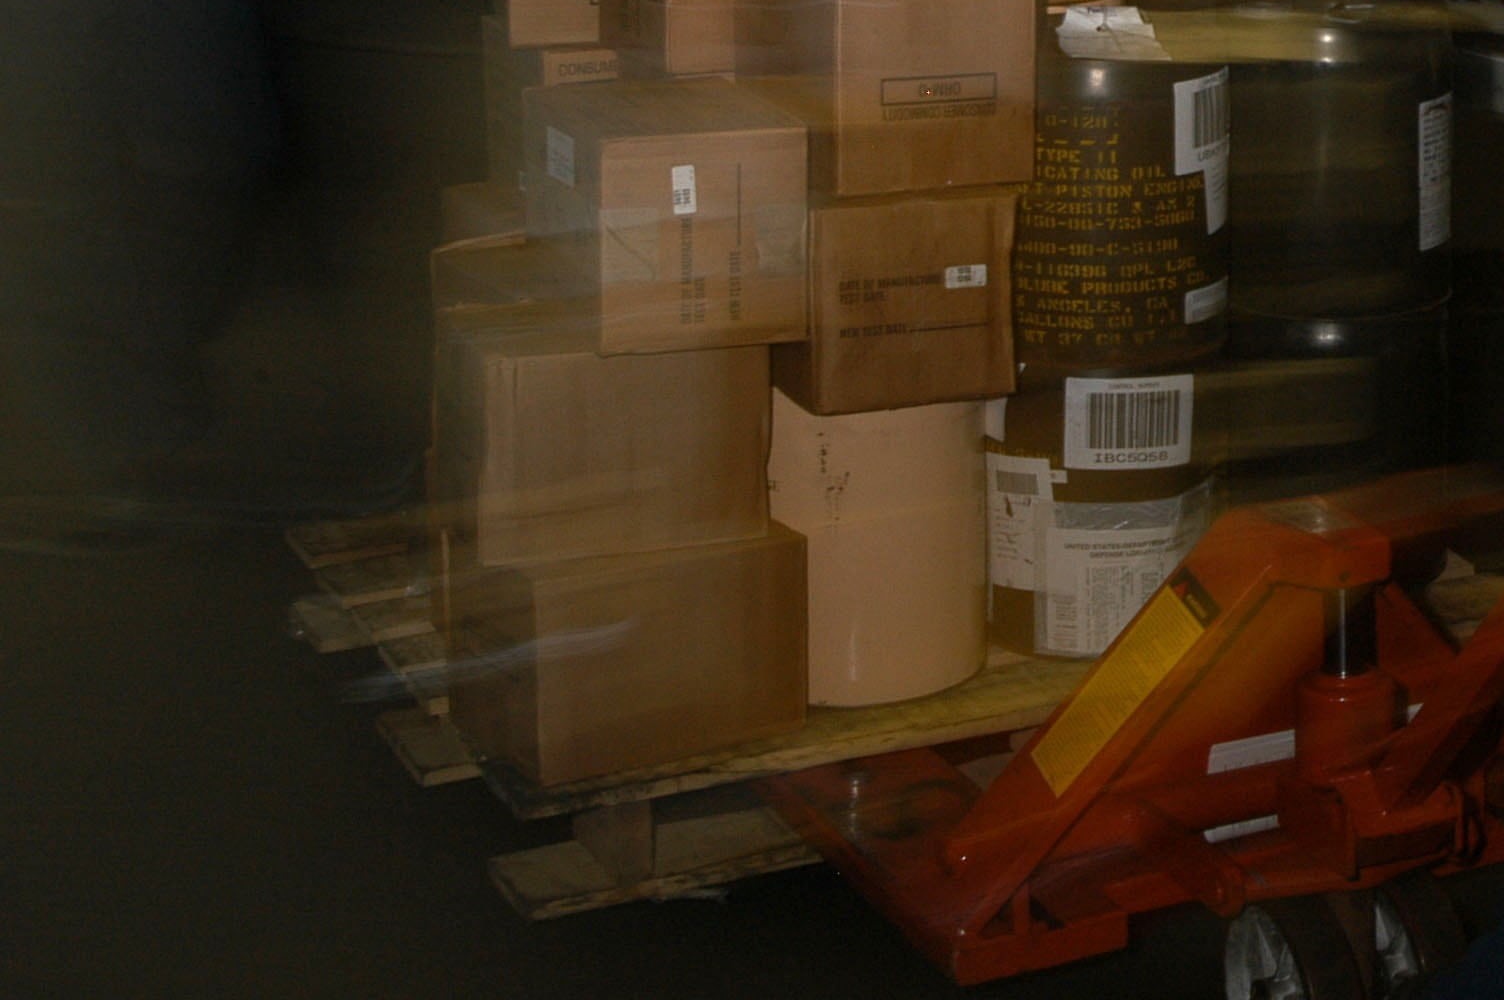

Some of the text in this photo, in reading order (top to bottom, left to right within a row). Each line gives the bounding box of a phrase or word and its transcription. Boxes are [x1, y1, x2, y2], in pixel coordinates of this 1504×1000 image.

[1036, 147, 1081, 163] TYPE
[1132, 165, 1167, 180] OIL
[1056, 183, 1132, 199] PISTON
[1080, 276, 1178, 296] PRODUCTS
